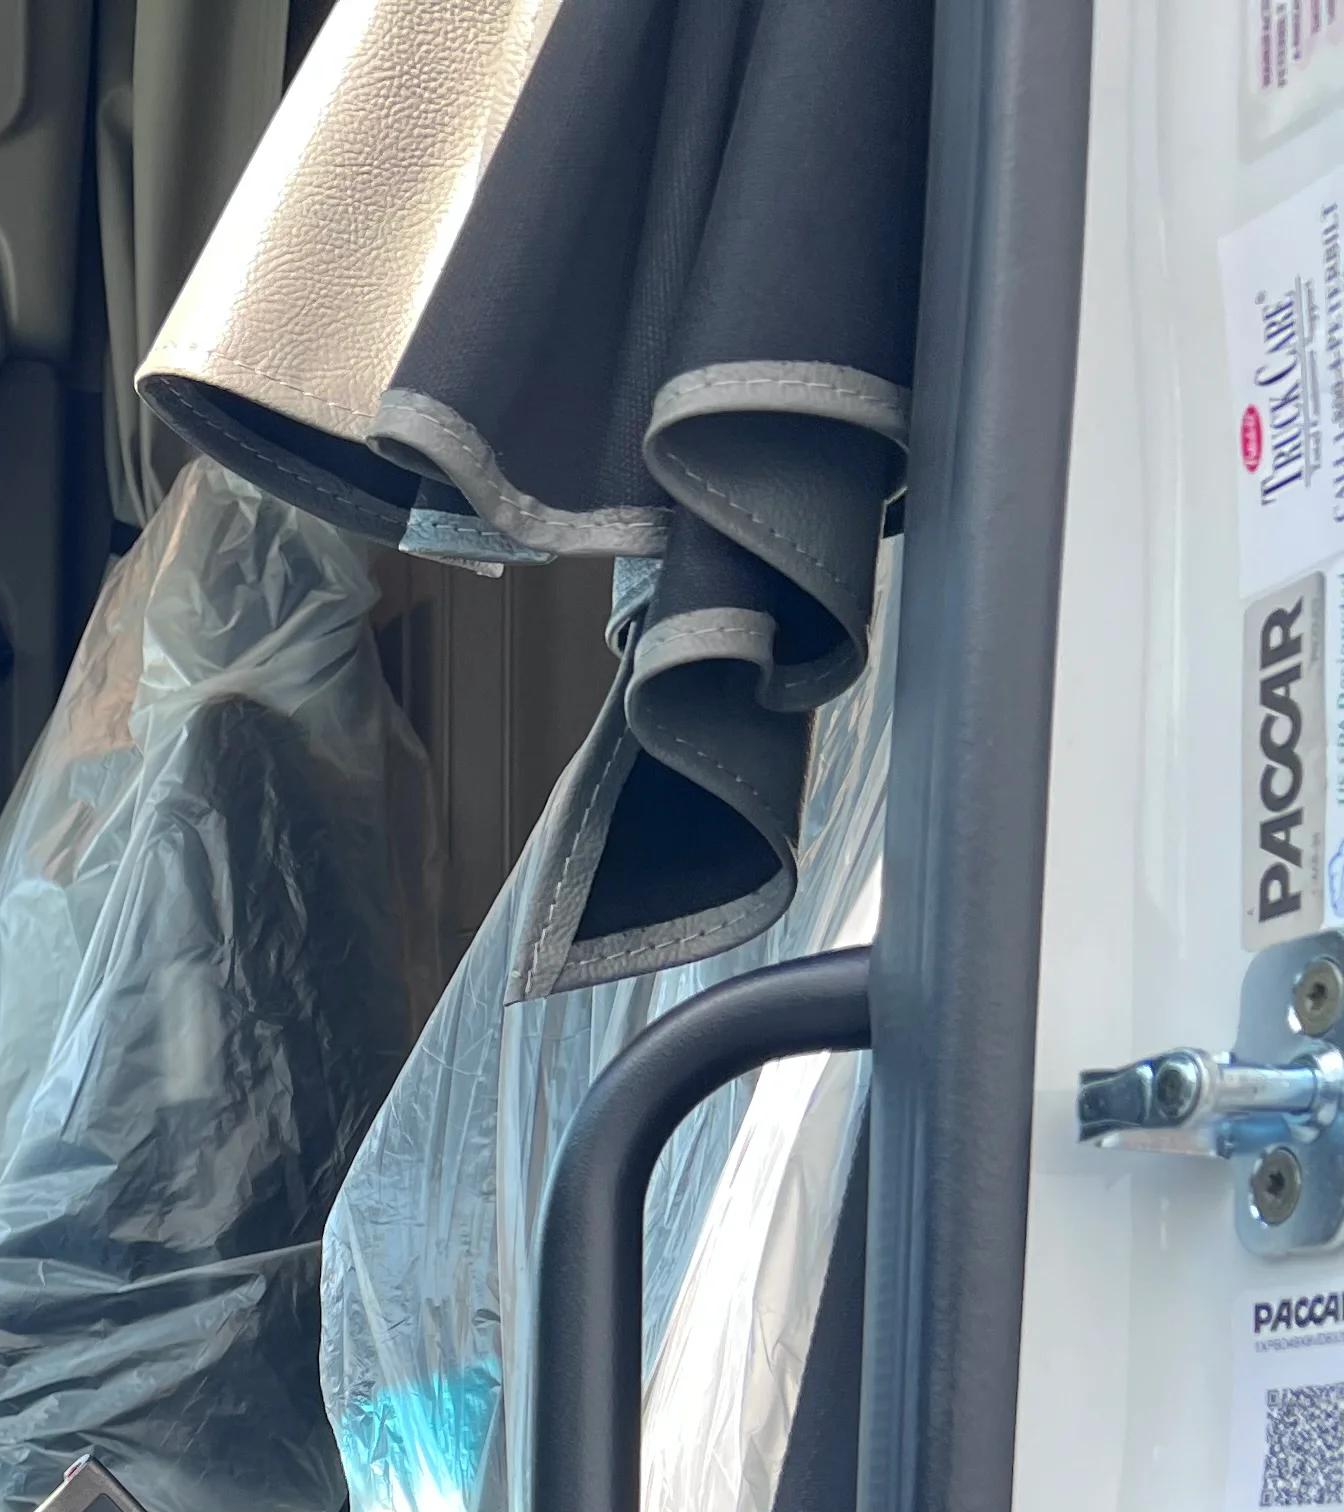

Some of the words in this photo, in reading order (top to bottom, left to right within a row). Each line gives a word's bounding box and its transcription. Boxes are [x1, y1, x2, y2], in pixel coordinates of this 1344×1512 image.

[1260, 382, 1303, 506] TRUCK
[1258, 596, 1304, 923] PACCAR
[1253, 1292, 1344, 1333] PACCA
